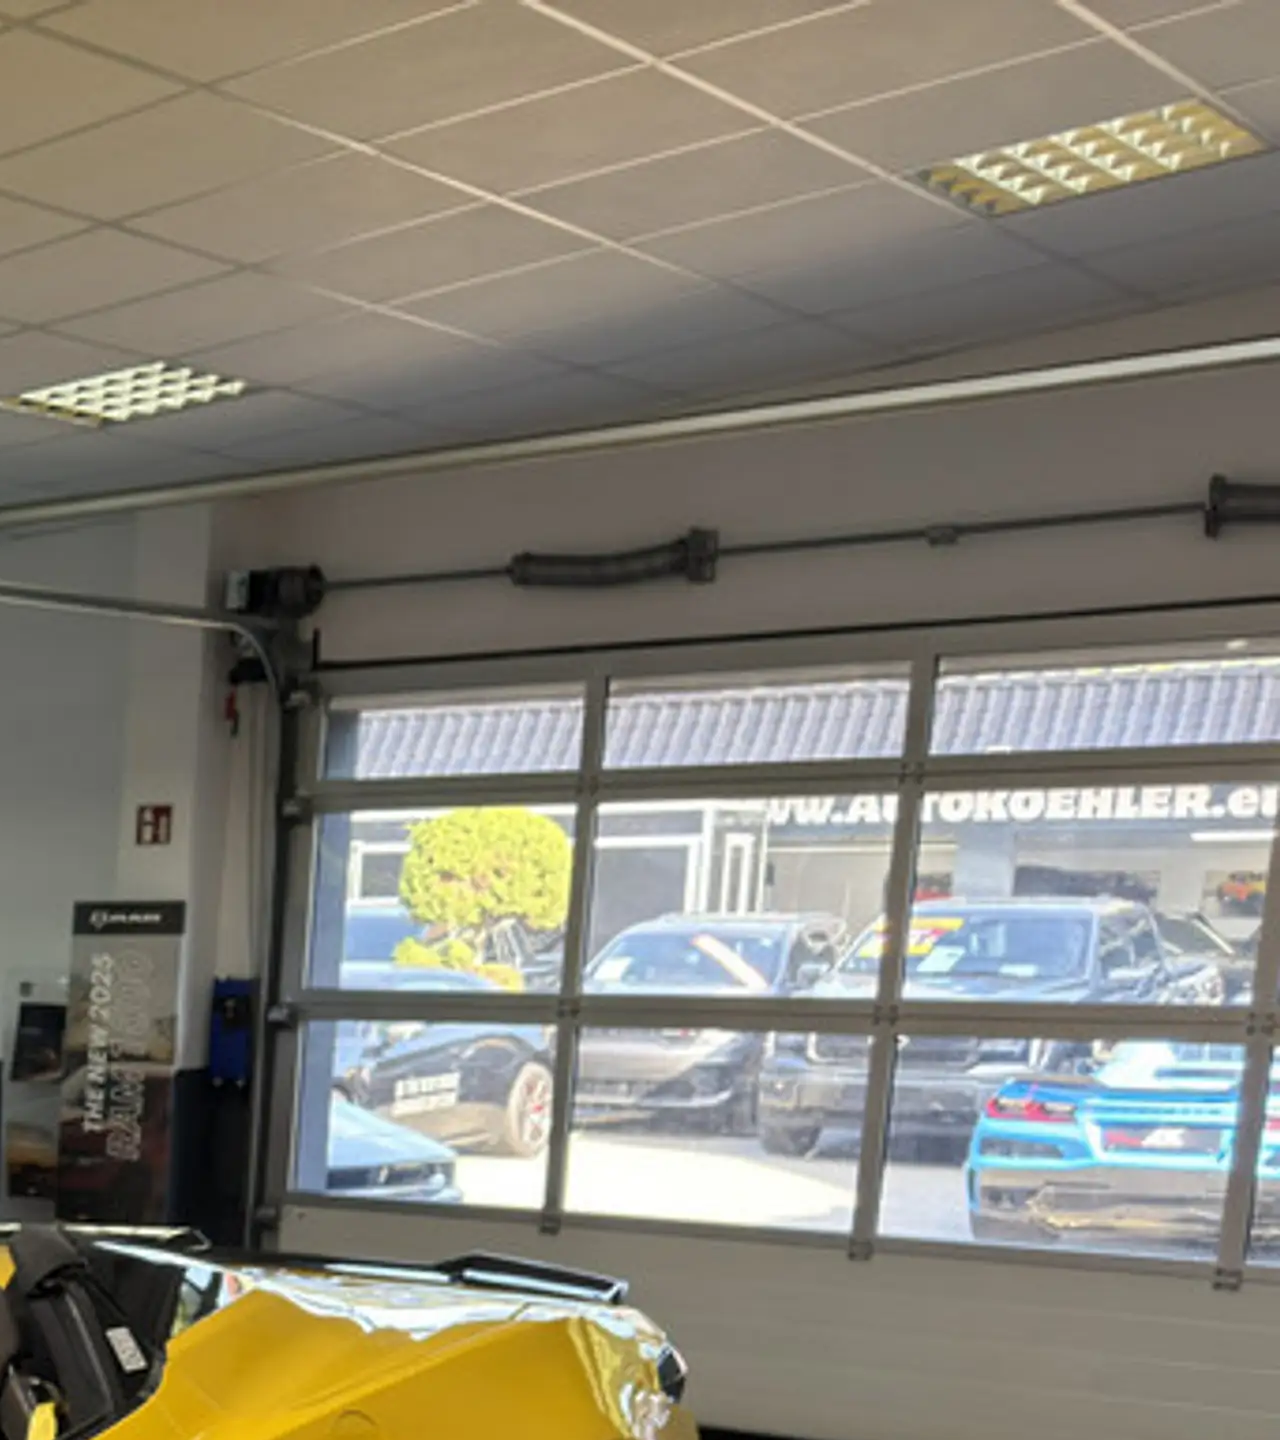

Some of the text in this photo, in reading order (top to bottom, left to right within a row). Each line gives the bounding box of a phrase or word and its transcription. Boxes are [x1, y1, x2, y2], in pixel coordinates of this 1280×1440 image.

[81, 951, 115, 1133] THE NEW 2025
